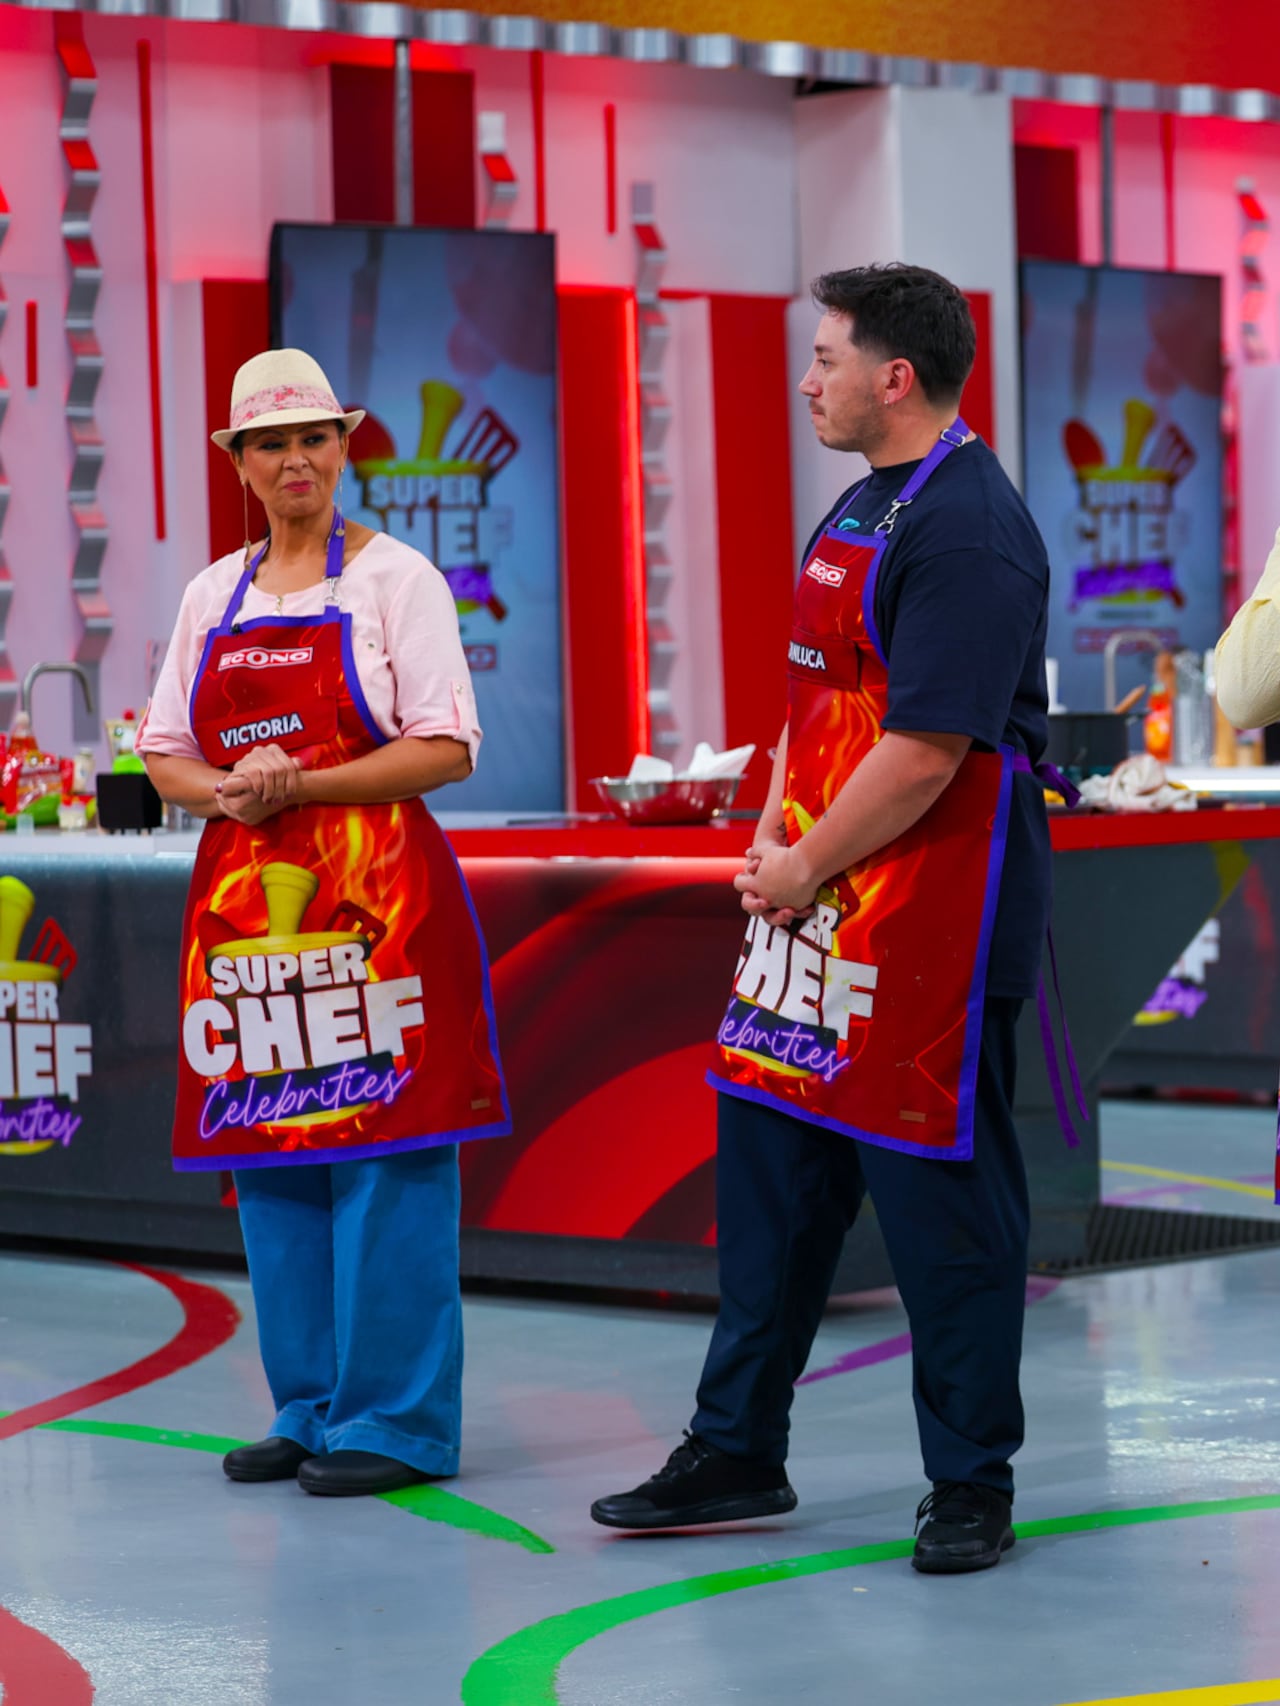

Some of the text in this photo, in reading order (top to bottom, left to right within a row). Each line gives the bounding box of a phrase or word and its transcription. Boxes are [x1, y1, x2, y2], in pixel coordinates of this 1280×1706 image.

[220, 713, 304, 749] VICTORIA
[0, 981, 59, 1020] PER
[211, 943, 368, 996] SUPER
[735, 915, 879, 1041] HEF
[0, 1022, 92, 1102] EF
[182, 975, 425, 1077] CHEF
[718, 998, 850, 1082] lebrities
[199, 1062, 413, 1140] Celebrities
